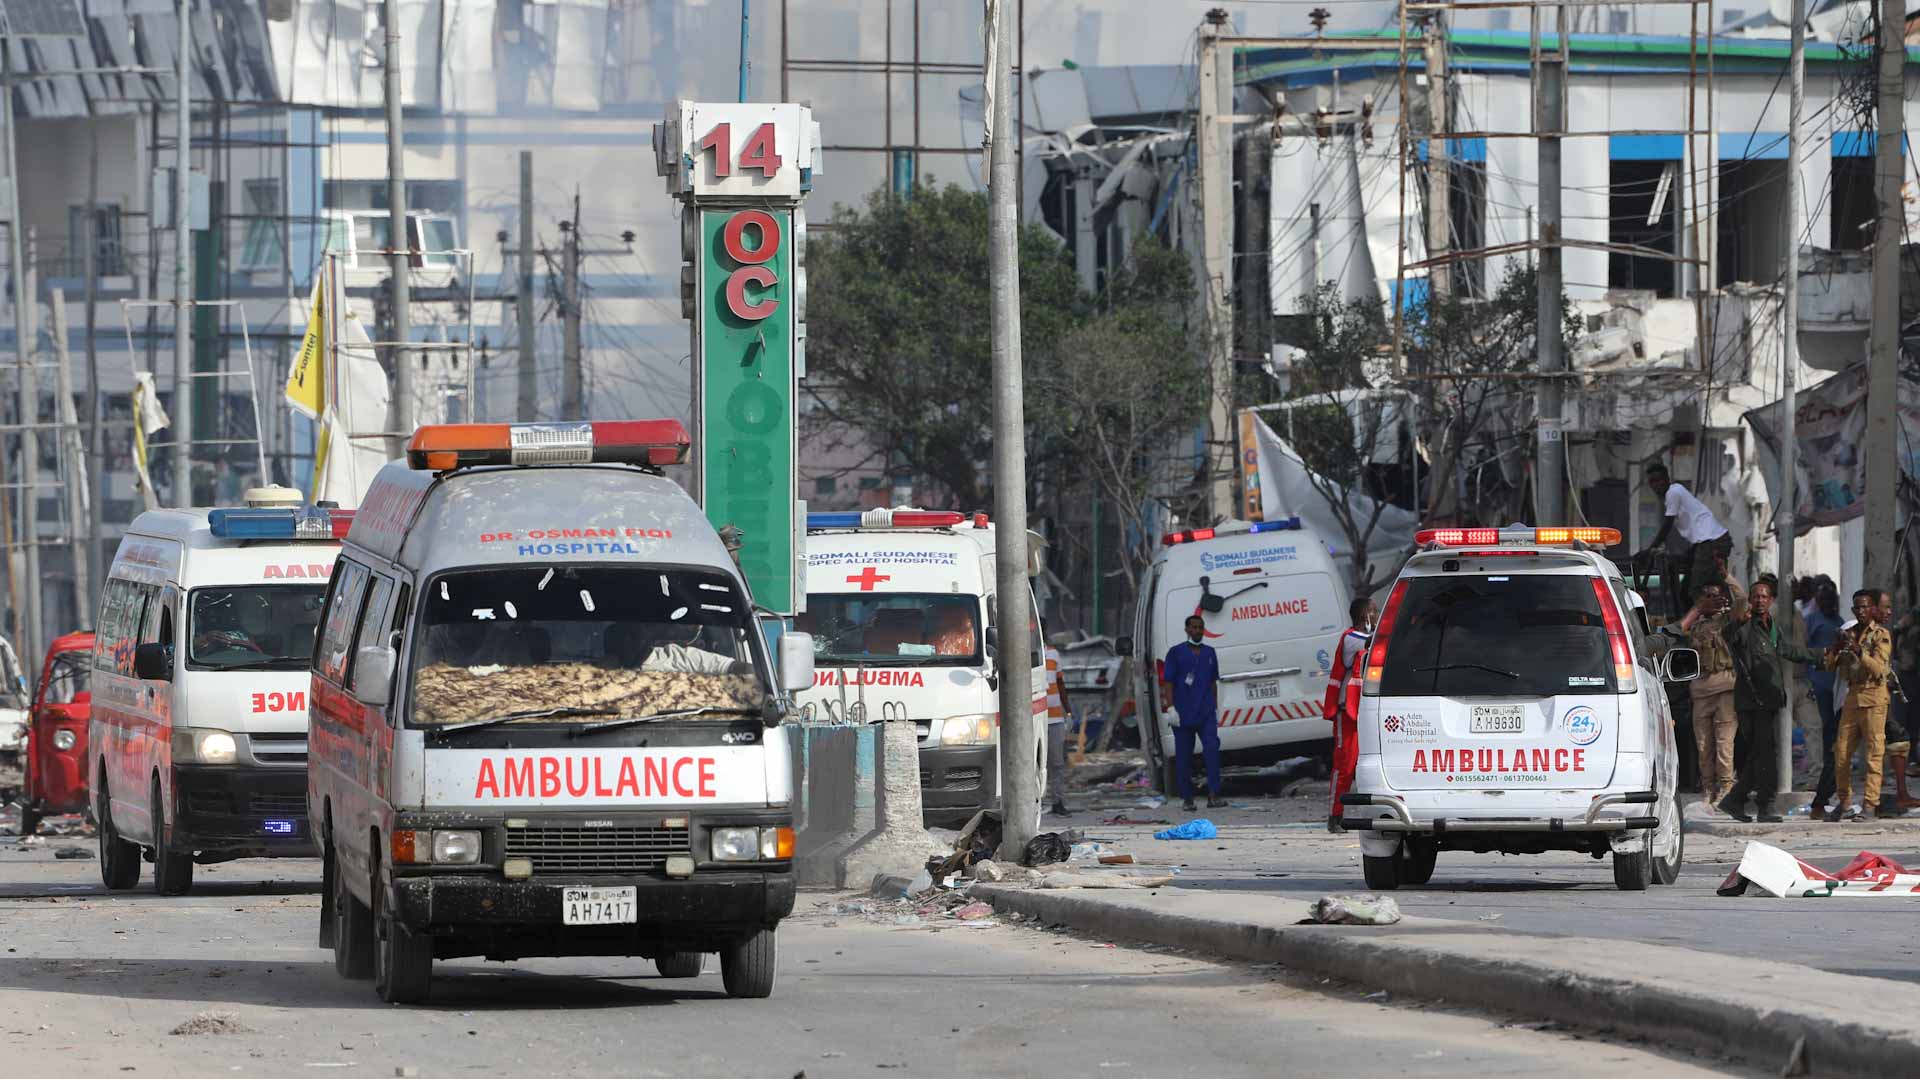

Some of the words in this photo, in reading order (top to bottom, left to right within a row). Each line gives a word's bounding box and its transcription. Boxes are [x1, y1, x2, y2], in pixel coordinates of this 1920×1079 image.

[702, 122, 783, 178] 14
[480, 532, 520, 543] DR.
[528, 528, 616, 539] OSMAN
[519, 543, 640, 556] HOSPITAL
[809, 551, 869, 560] SOMALI
[872, 551, 958, 559] SUDANESE
[1214, 552, 1248, 562] SOMALI
[1249, 546, 1297, 557] SUDANESE
[1231, 600, 1309, 621] AMBULANCE
[1406, 728, 1437, 737] Hospital
[1412, 748, 1586, 773] AMBULANCE
[475, 756, 717, 799] AMBULANCE
[584, 820, 613, 828] NISSAN
